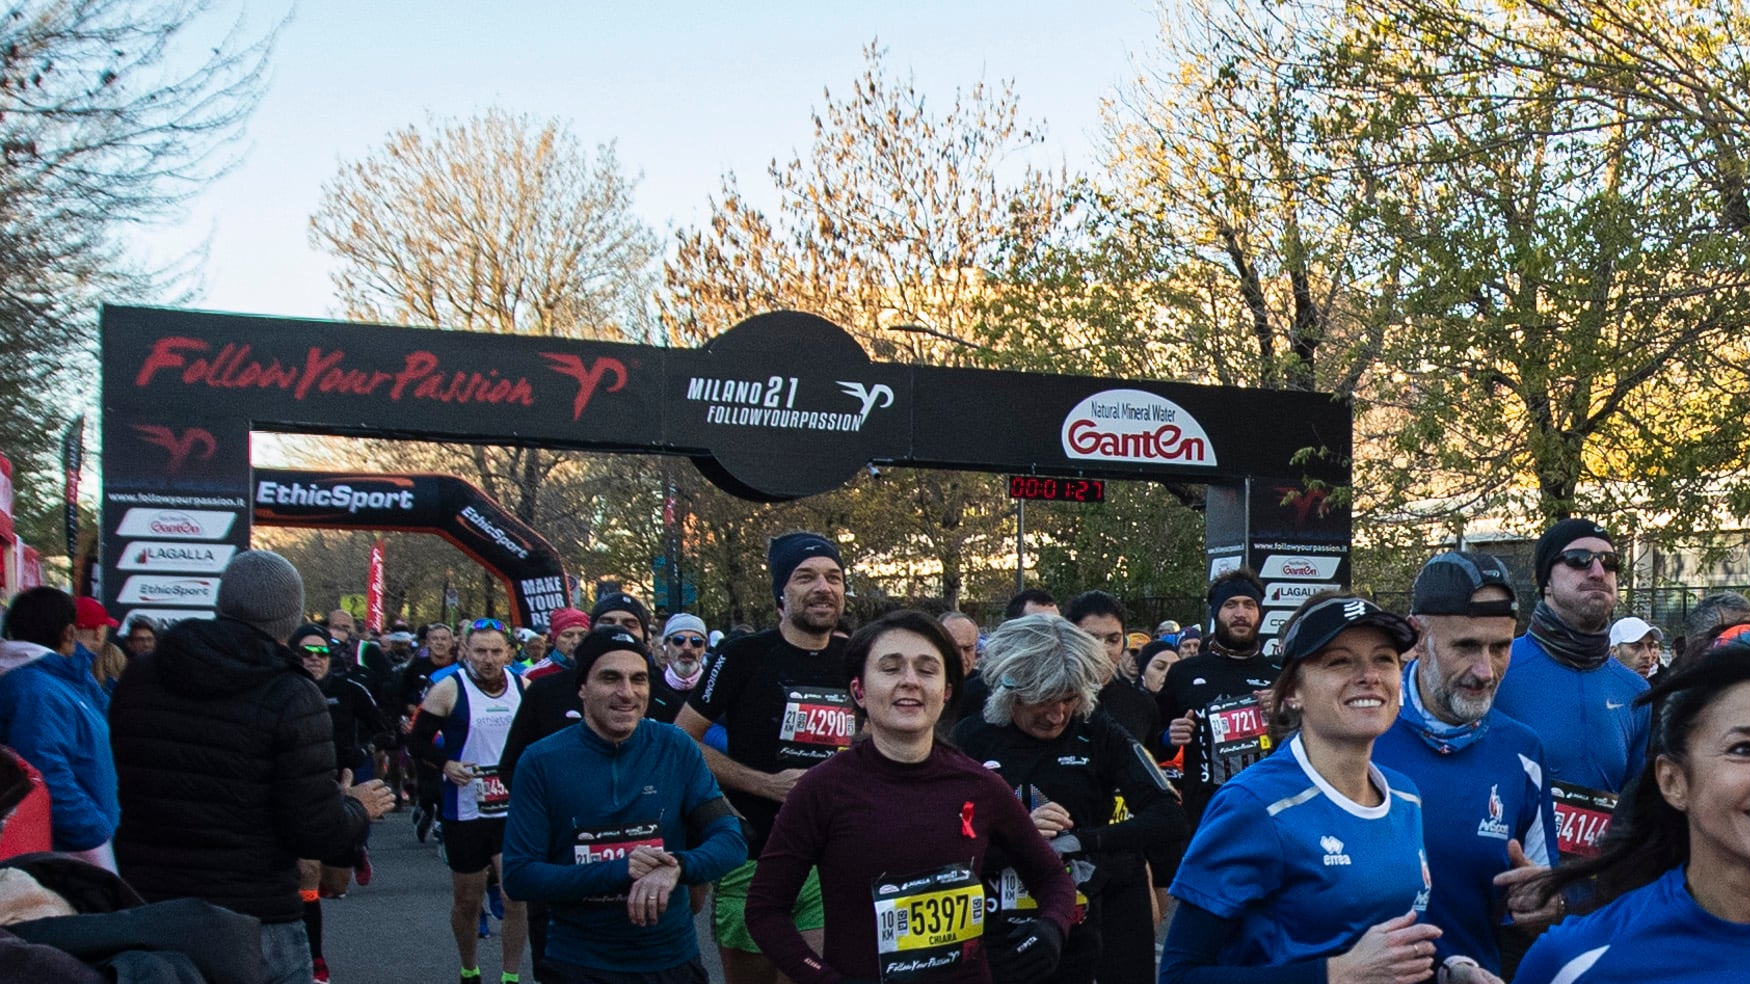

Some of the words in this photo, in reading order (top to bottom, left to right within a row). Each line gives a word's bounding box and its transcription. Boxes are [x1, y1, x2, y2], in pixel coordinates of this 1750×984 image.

[686, 378, 763, 404] MILANO
[763, 376, 799, 408] 21
[707, 406, 862, 432] FOLLOWYOURPASSION
[1091, 401, 1120, 418] Natural
[1121, 403, 1150, 421] Mineral
[1152, 406, 1176, 422] Water
[255, 481, 415, 513] EthicSport
[460, 506, 530, 560] EthicSport
[148, 548, 214, 561] LAGALLA
[1253, 542, 1348, 553] www.followyourpassion.it
[140, 584, 210, 597] EthicSport
[521, 576, 562, 595] MAKE
[1280, 587, 1324, 597] LAGALL
[525, 593, 565, 611] YOUR
[531, 611, 552, 627] RE
[785, 710, 797, 724] 21
[806, 709, 846, 737] 4290
[1230, 710, 1257, 733] 721
[1004, 875, 1016, 890] 10
[881, 910, 894, 927] 10
[910, 894, 969, 936] 5397
[881, 928, 895, 942] KM
[928, 932, 957, 945] CHIARA
